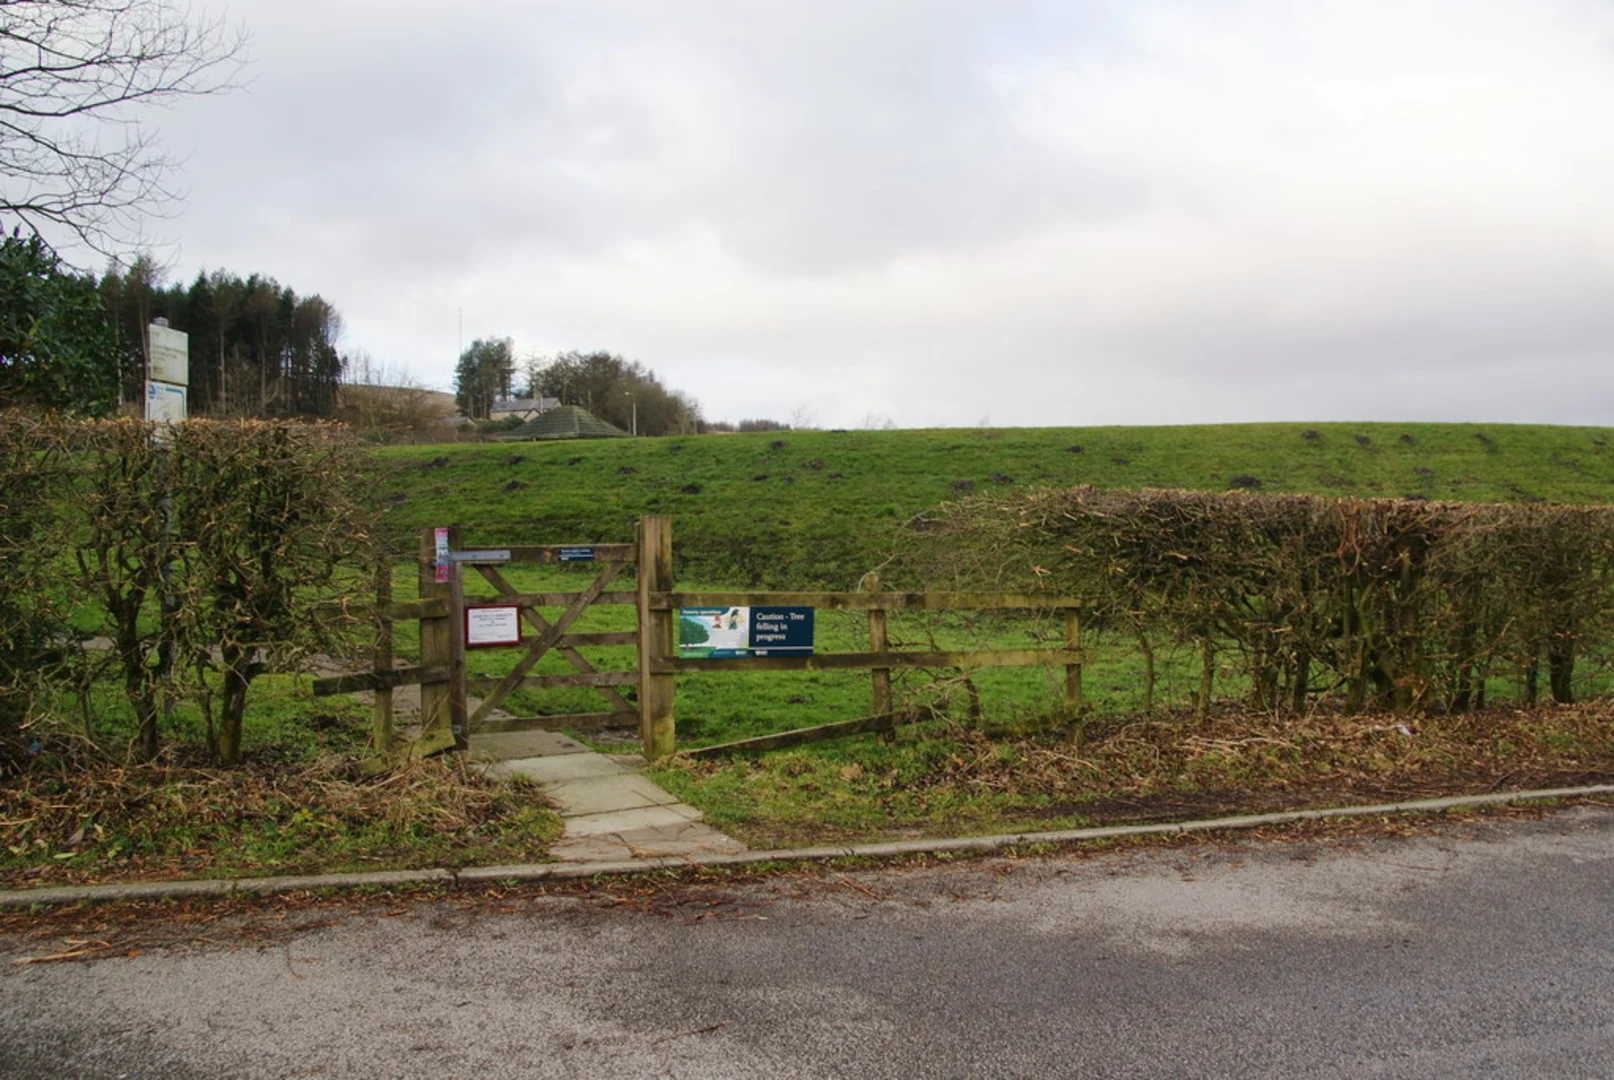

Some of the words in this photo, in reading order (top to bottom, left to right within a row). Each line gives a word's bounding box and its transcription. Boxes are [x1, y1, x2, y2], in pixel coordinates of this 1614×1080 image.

[756, 622, 779, 632] felling
[779, 622, 788, 630] in
[756, 634, 786, 642] progress
